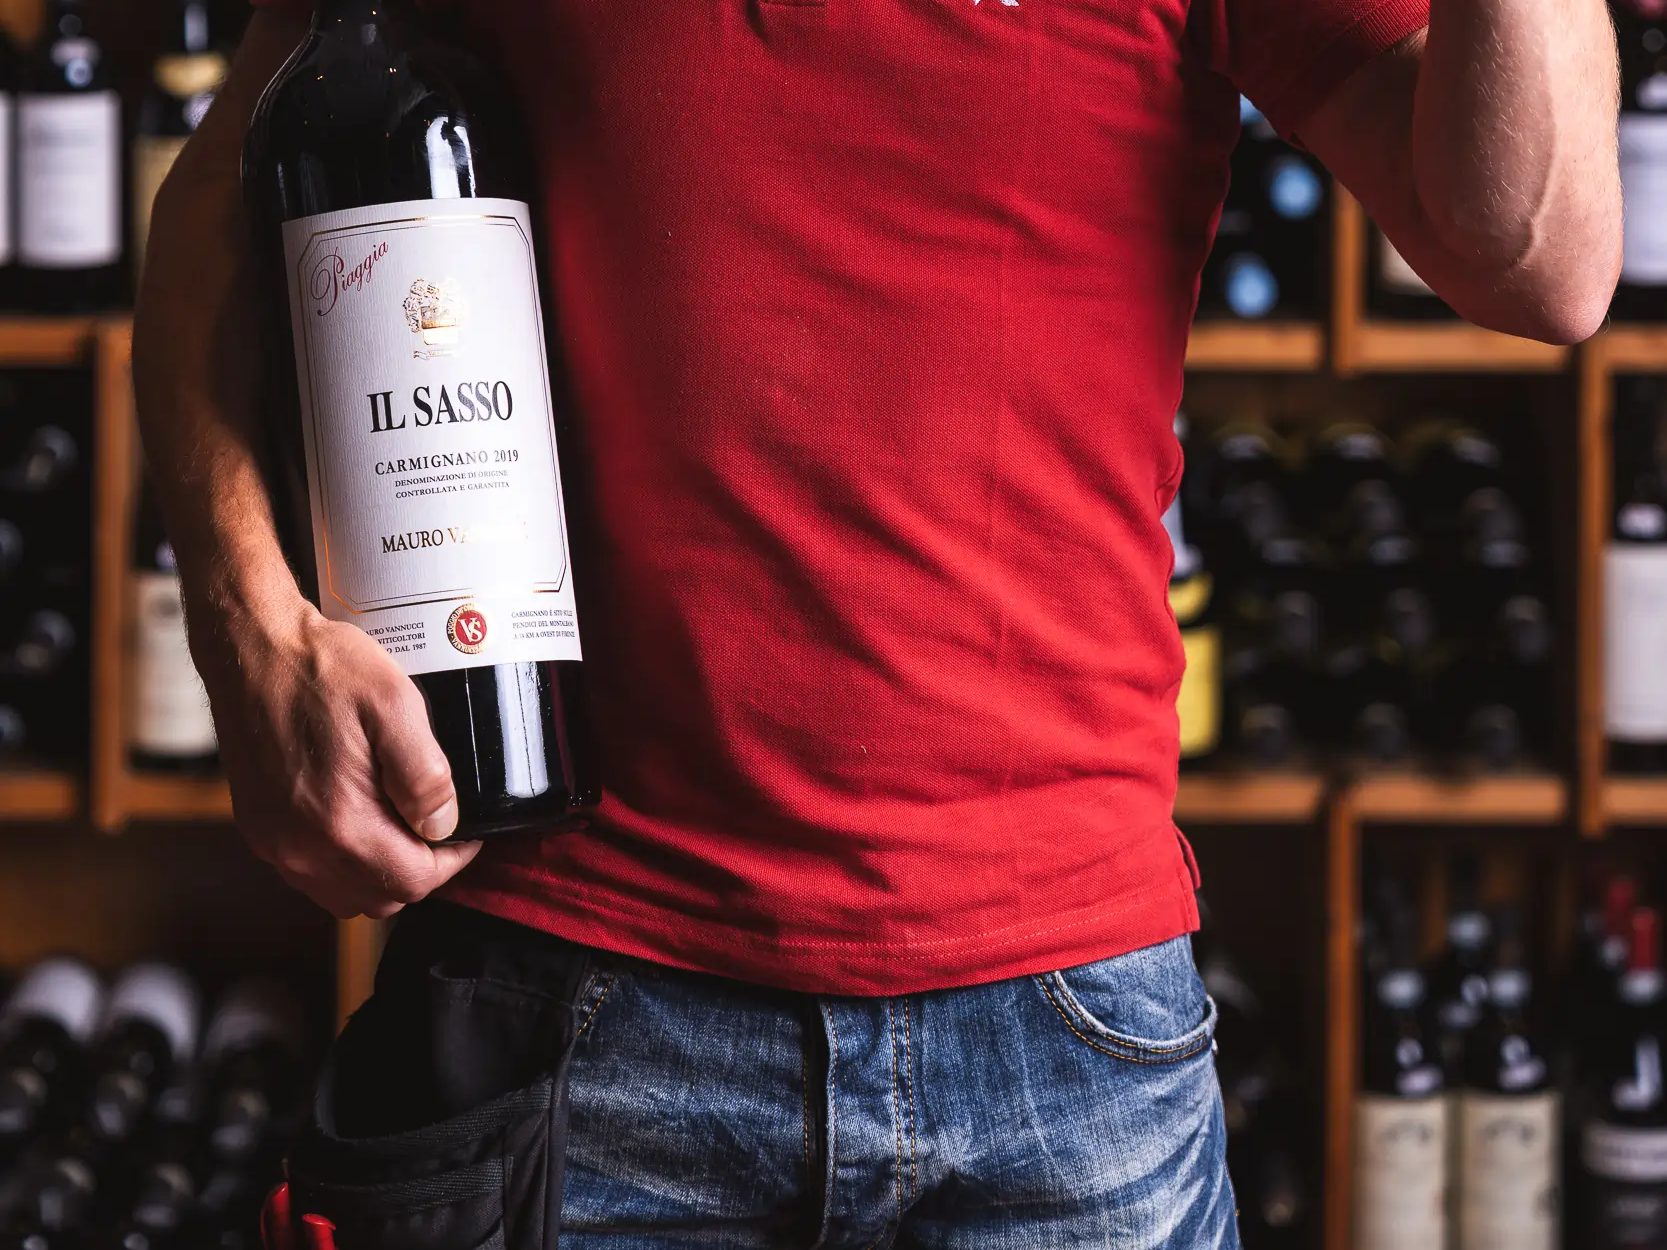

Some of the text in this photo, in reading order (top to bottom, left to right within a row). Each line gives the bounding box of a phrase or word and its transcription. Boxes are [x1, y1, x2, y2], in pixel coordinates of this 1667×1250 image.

[311, 241, 389, 316] Piaggia
[367, 380, 513, 433] IL SASSO
[375, 449, 519, 476] CARMIGNANO 2019
[395, 469, 509, 487] DENOMINAZIONE DI ORIGINE
[395, 485, 458, 499] CONTROLLATA
[467, 481, 510, 491] GARANTITA
[381, 529, 444, 554] MAURO
[511, 609, 549, 618] CARMIGNANO
[366, 621, 424, 637] AURO VANNUCCI
[512, 621, 537, 629] PENDICI
[537, 620, 549, 628] DEL
[377, 632, 426, 645] VITICOLTORI
[394, 645, 411, 653] DAL
[412, 642, 427, 651] 1987
